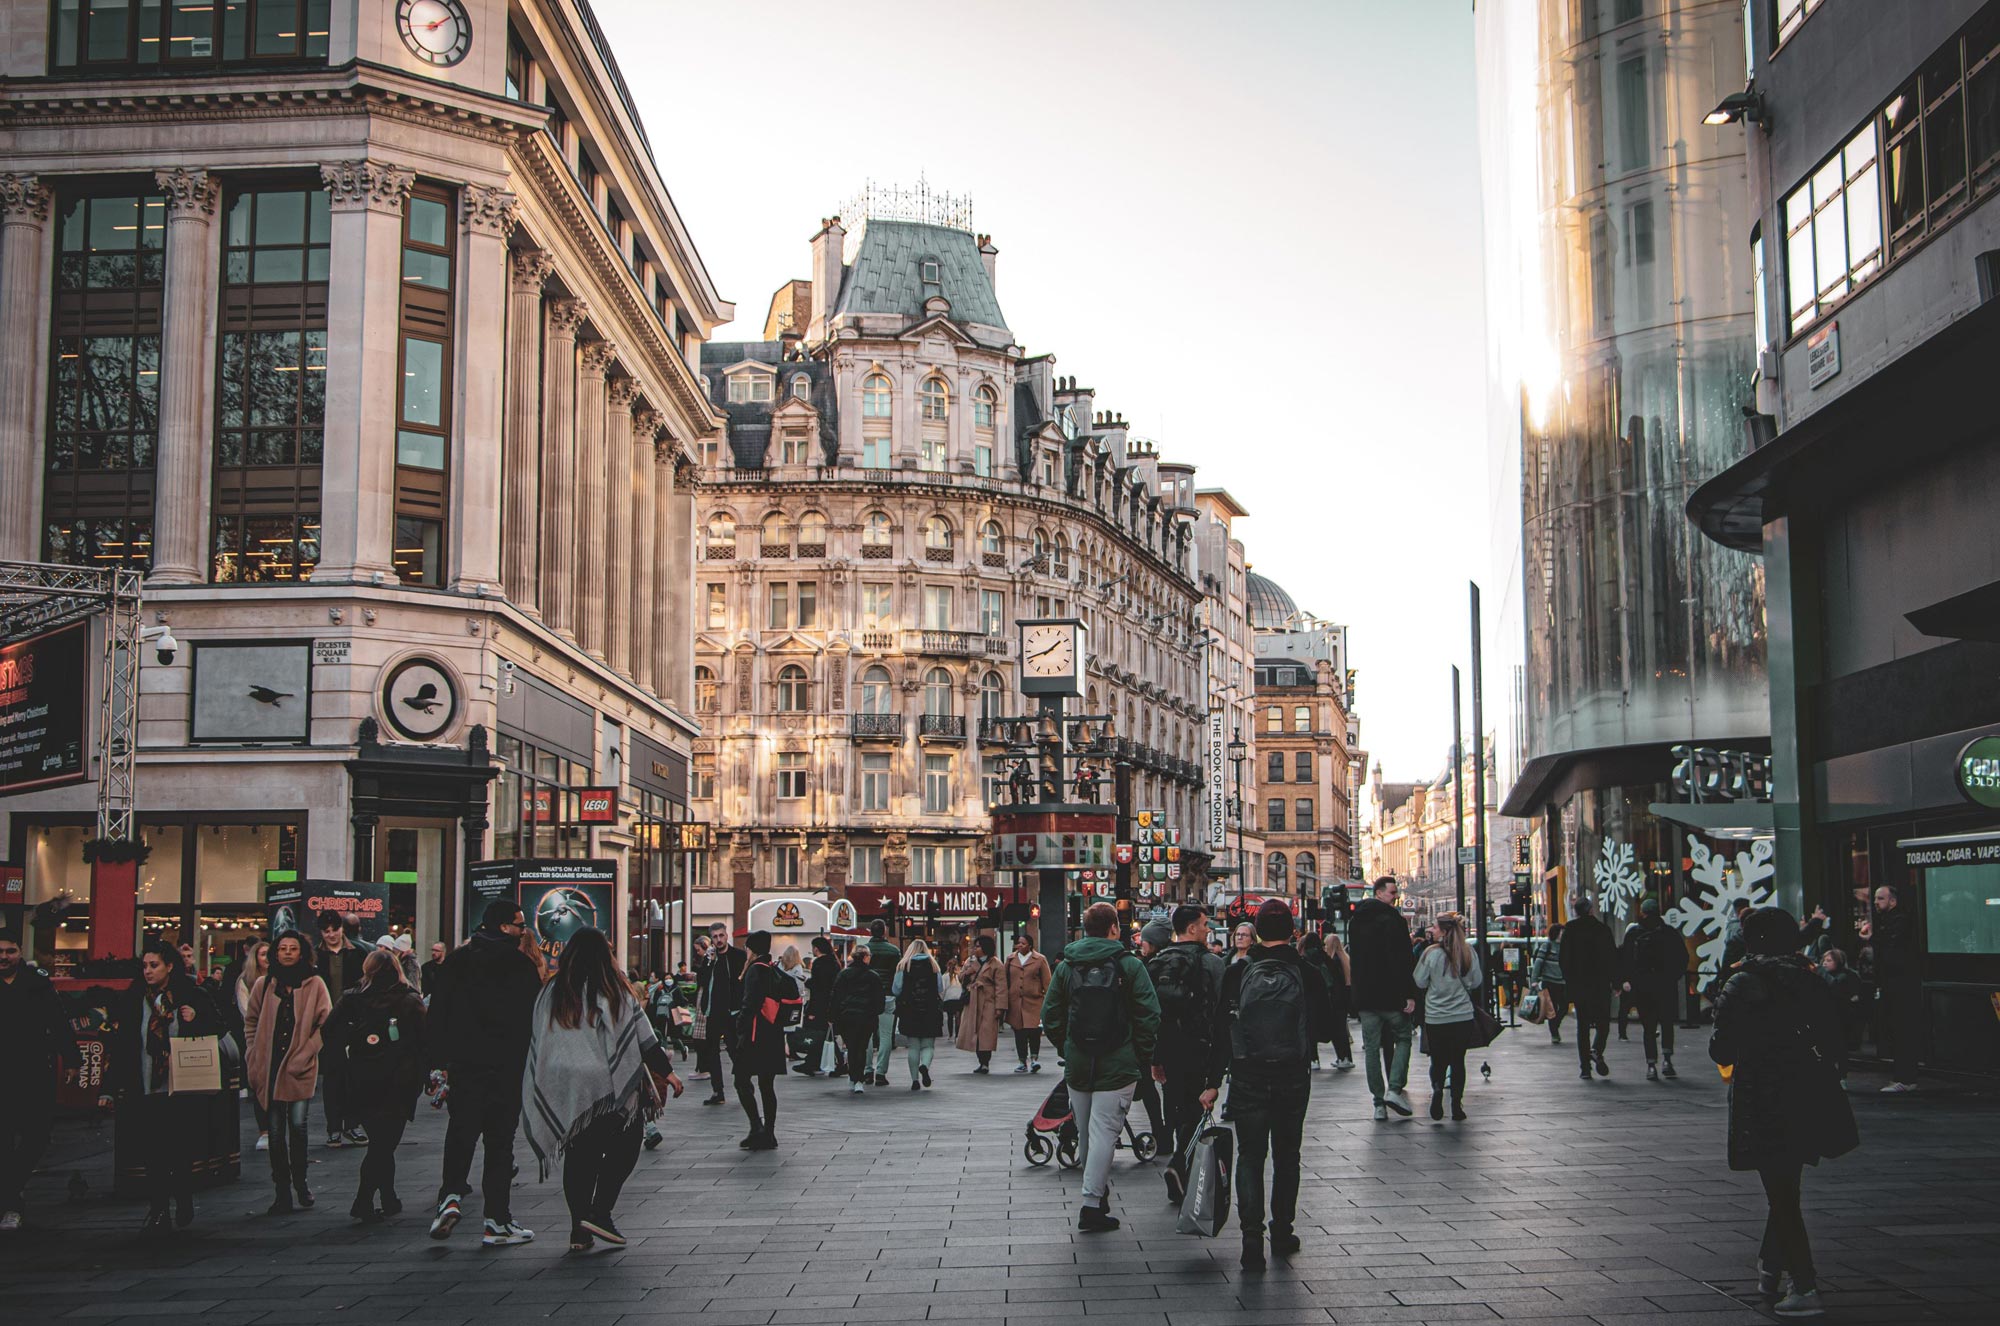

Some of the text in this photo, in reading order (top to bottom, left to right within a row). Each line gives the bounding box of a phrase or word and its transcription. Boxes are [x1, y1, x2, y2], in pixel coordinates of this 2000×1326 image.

[313, 641, 351, 649] LEICESTER
[316, 649, 348, 657] SQUARE
[1212, 717, 1223, 843] THE BOOK OF MORMON
[1966, 776, 1994, 787] SOLD
[584, 799, 609, 812] LEGO
[1906, 850, 1941, 865] TOBACCO
[1946, 847, 1972, 861] CIGAR
[6, 879, 23, 892] LEGO
[333, 889, 355, 897] Welcome
[307, 896, 383, 912] CHRISTMAS
[898, 891, 929, 911] PRET
[943, 891, 988, 911] MANGER
[89, 1041, 104, 1086] @CHRIS
